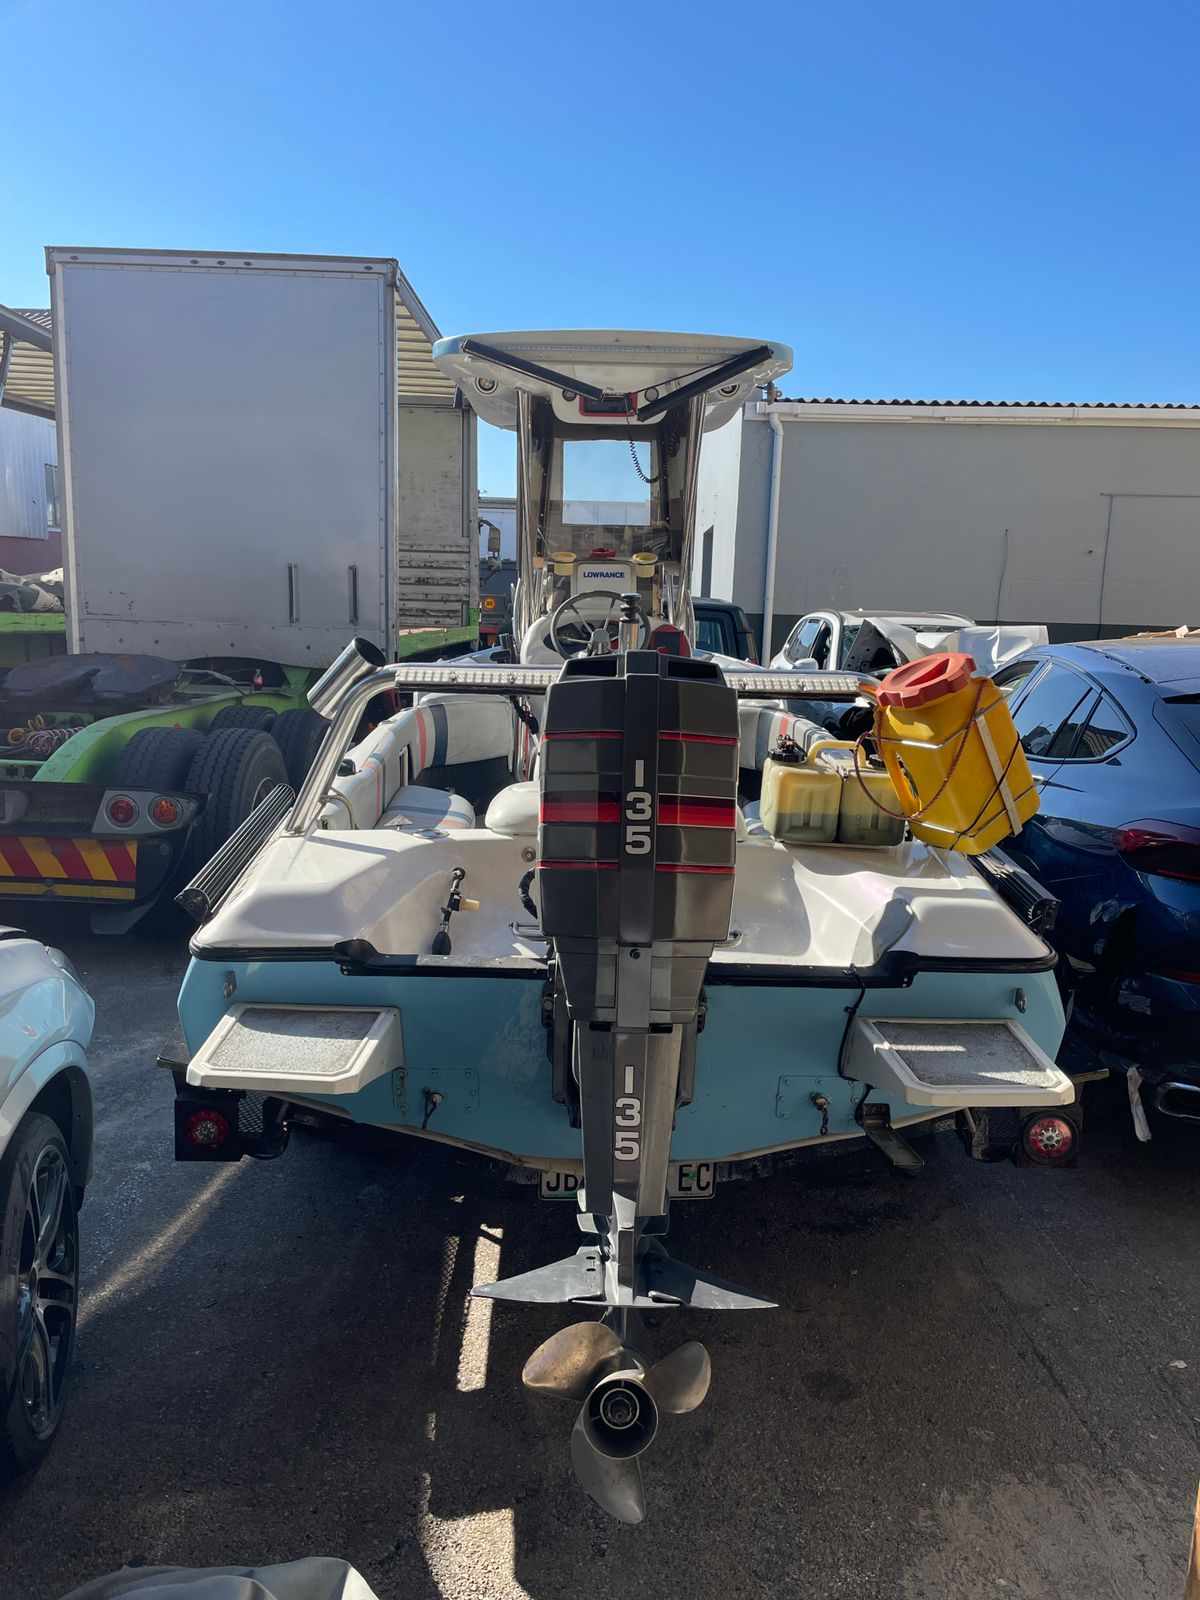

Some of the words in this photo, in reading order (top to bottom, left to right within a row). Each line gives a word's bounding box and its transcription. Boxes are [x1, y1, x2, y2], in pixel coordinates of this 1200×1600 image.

[583, 571, 625, 579] LOWRANCE
[546, 1172, 584, 1192] JD
[678, 1163, 711, 1192] EC
